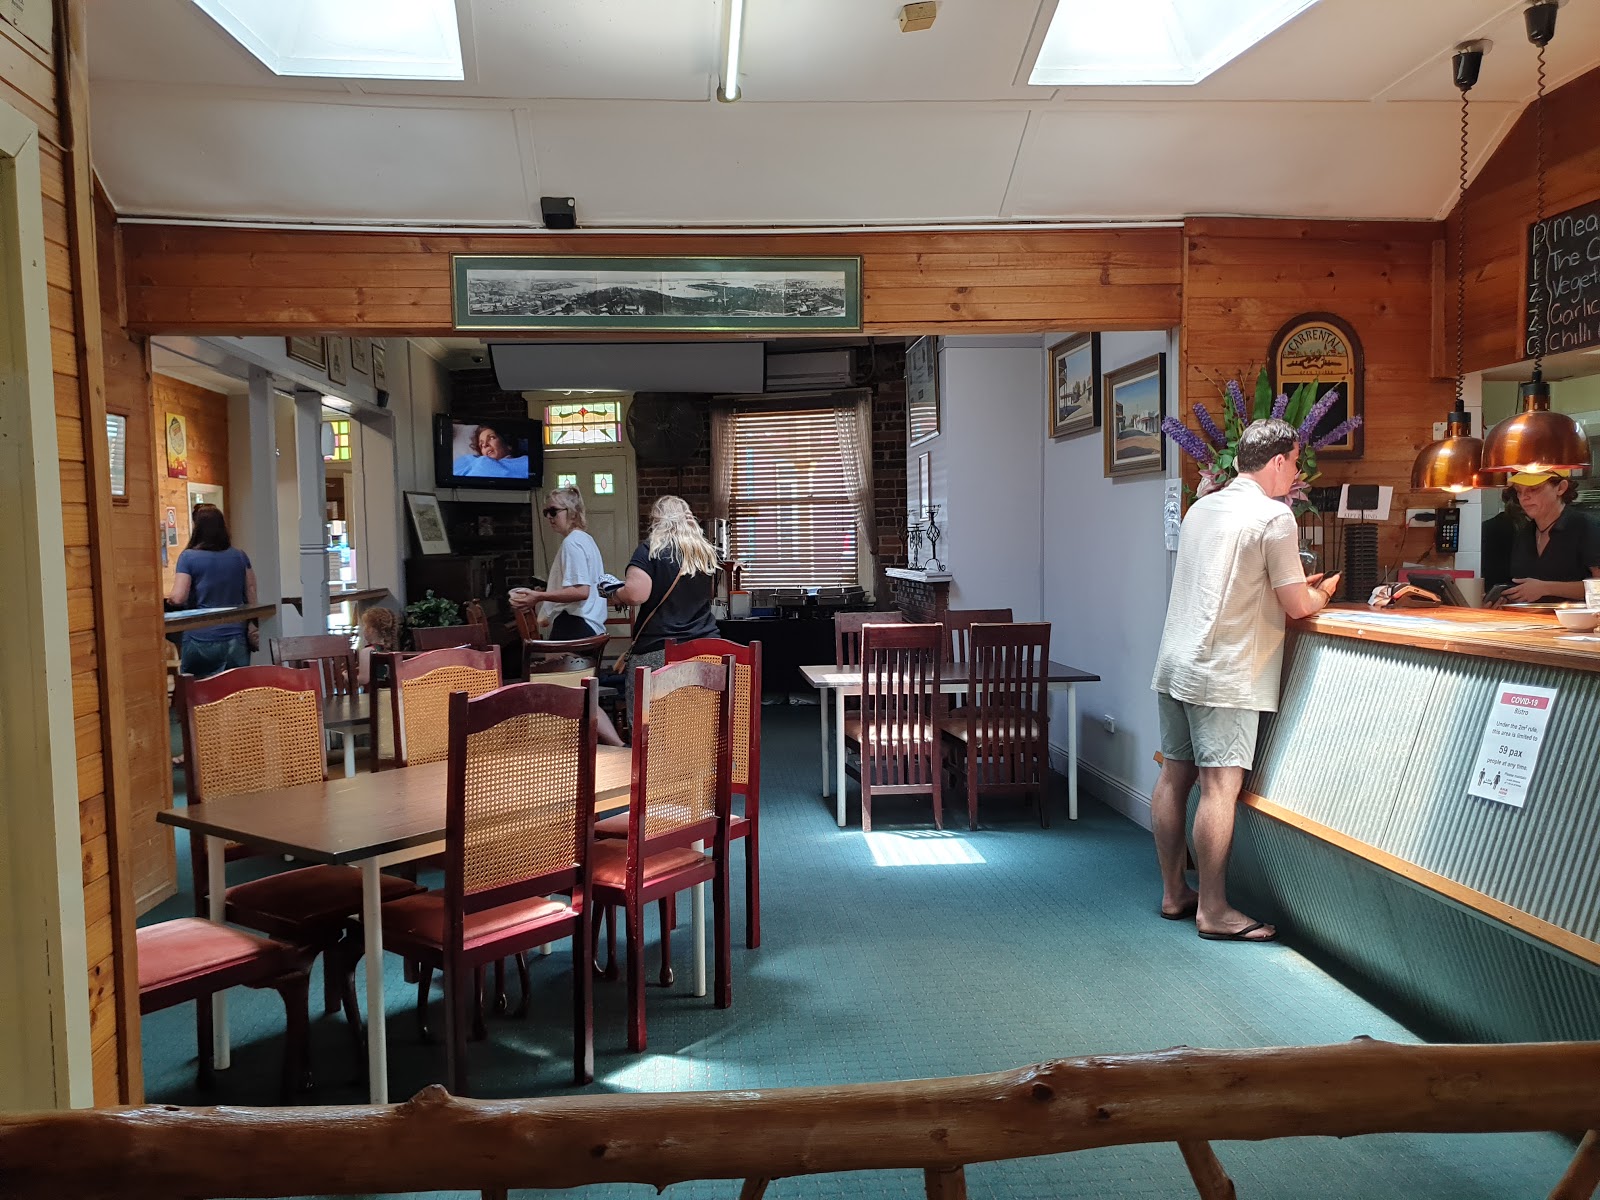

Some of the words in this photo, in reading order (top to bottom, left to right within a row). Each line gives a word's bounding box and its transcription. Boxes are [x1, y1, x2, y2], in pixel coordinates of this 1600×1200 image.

[1550, 249, 1580, 272] The
[1550, 297, 1600, 325] Garlic
[1510, 696, 1539, 707] COVID-19
[1517, 732, 1533, 741] limited
[1498, 745, 1508, 755] 59
[1508, 748, 1523, 758] pax
[1486, 758, 1501, 766] people
